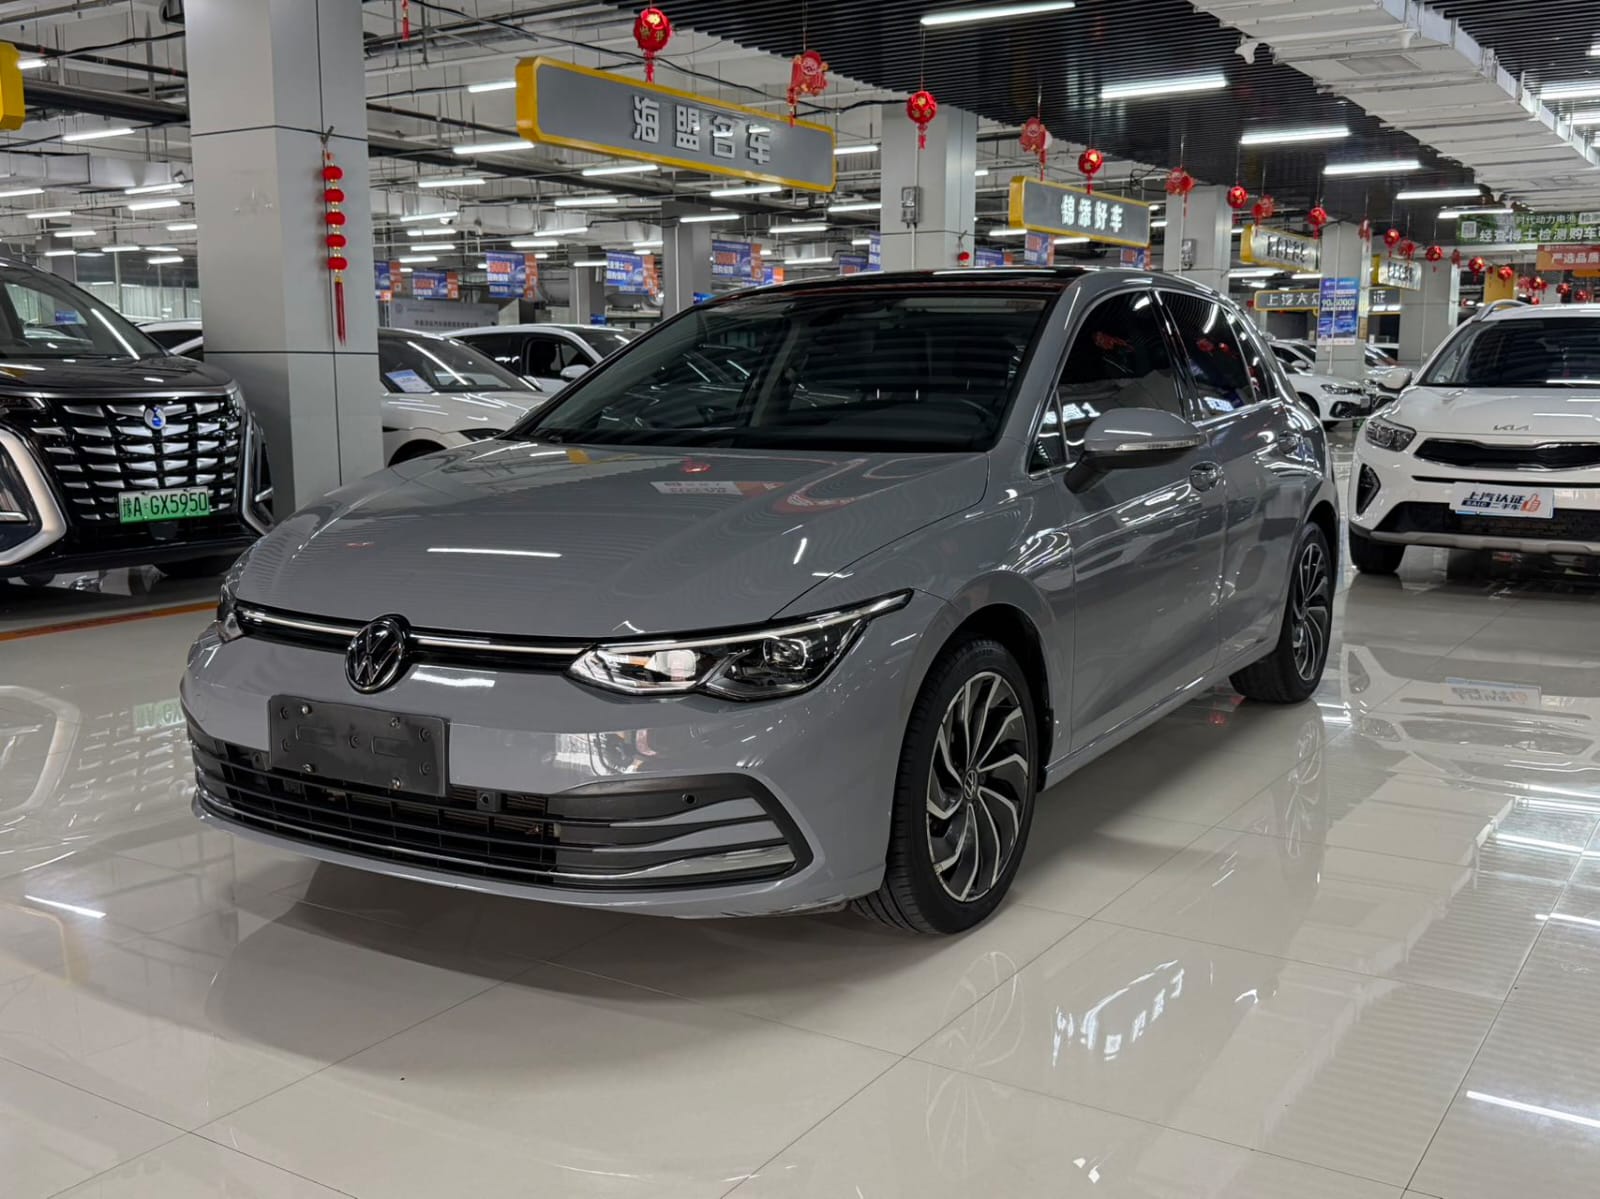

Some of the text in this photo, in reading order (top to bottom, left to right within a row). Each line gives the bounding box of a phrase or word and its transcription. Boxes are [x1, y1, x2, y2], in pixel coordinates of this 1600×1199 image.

[633, 95, 771, 164] 海盟名车
[150, 491, 207, 515] GX5950
[1464, 491, 1526, 504] 上汽认证
